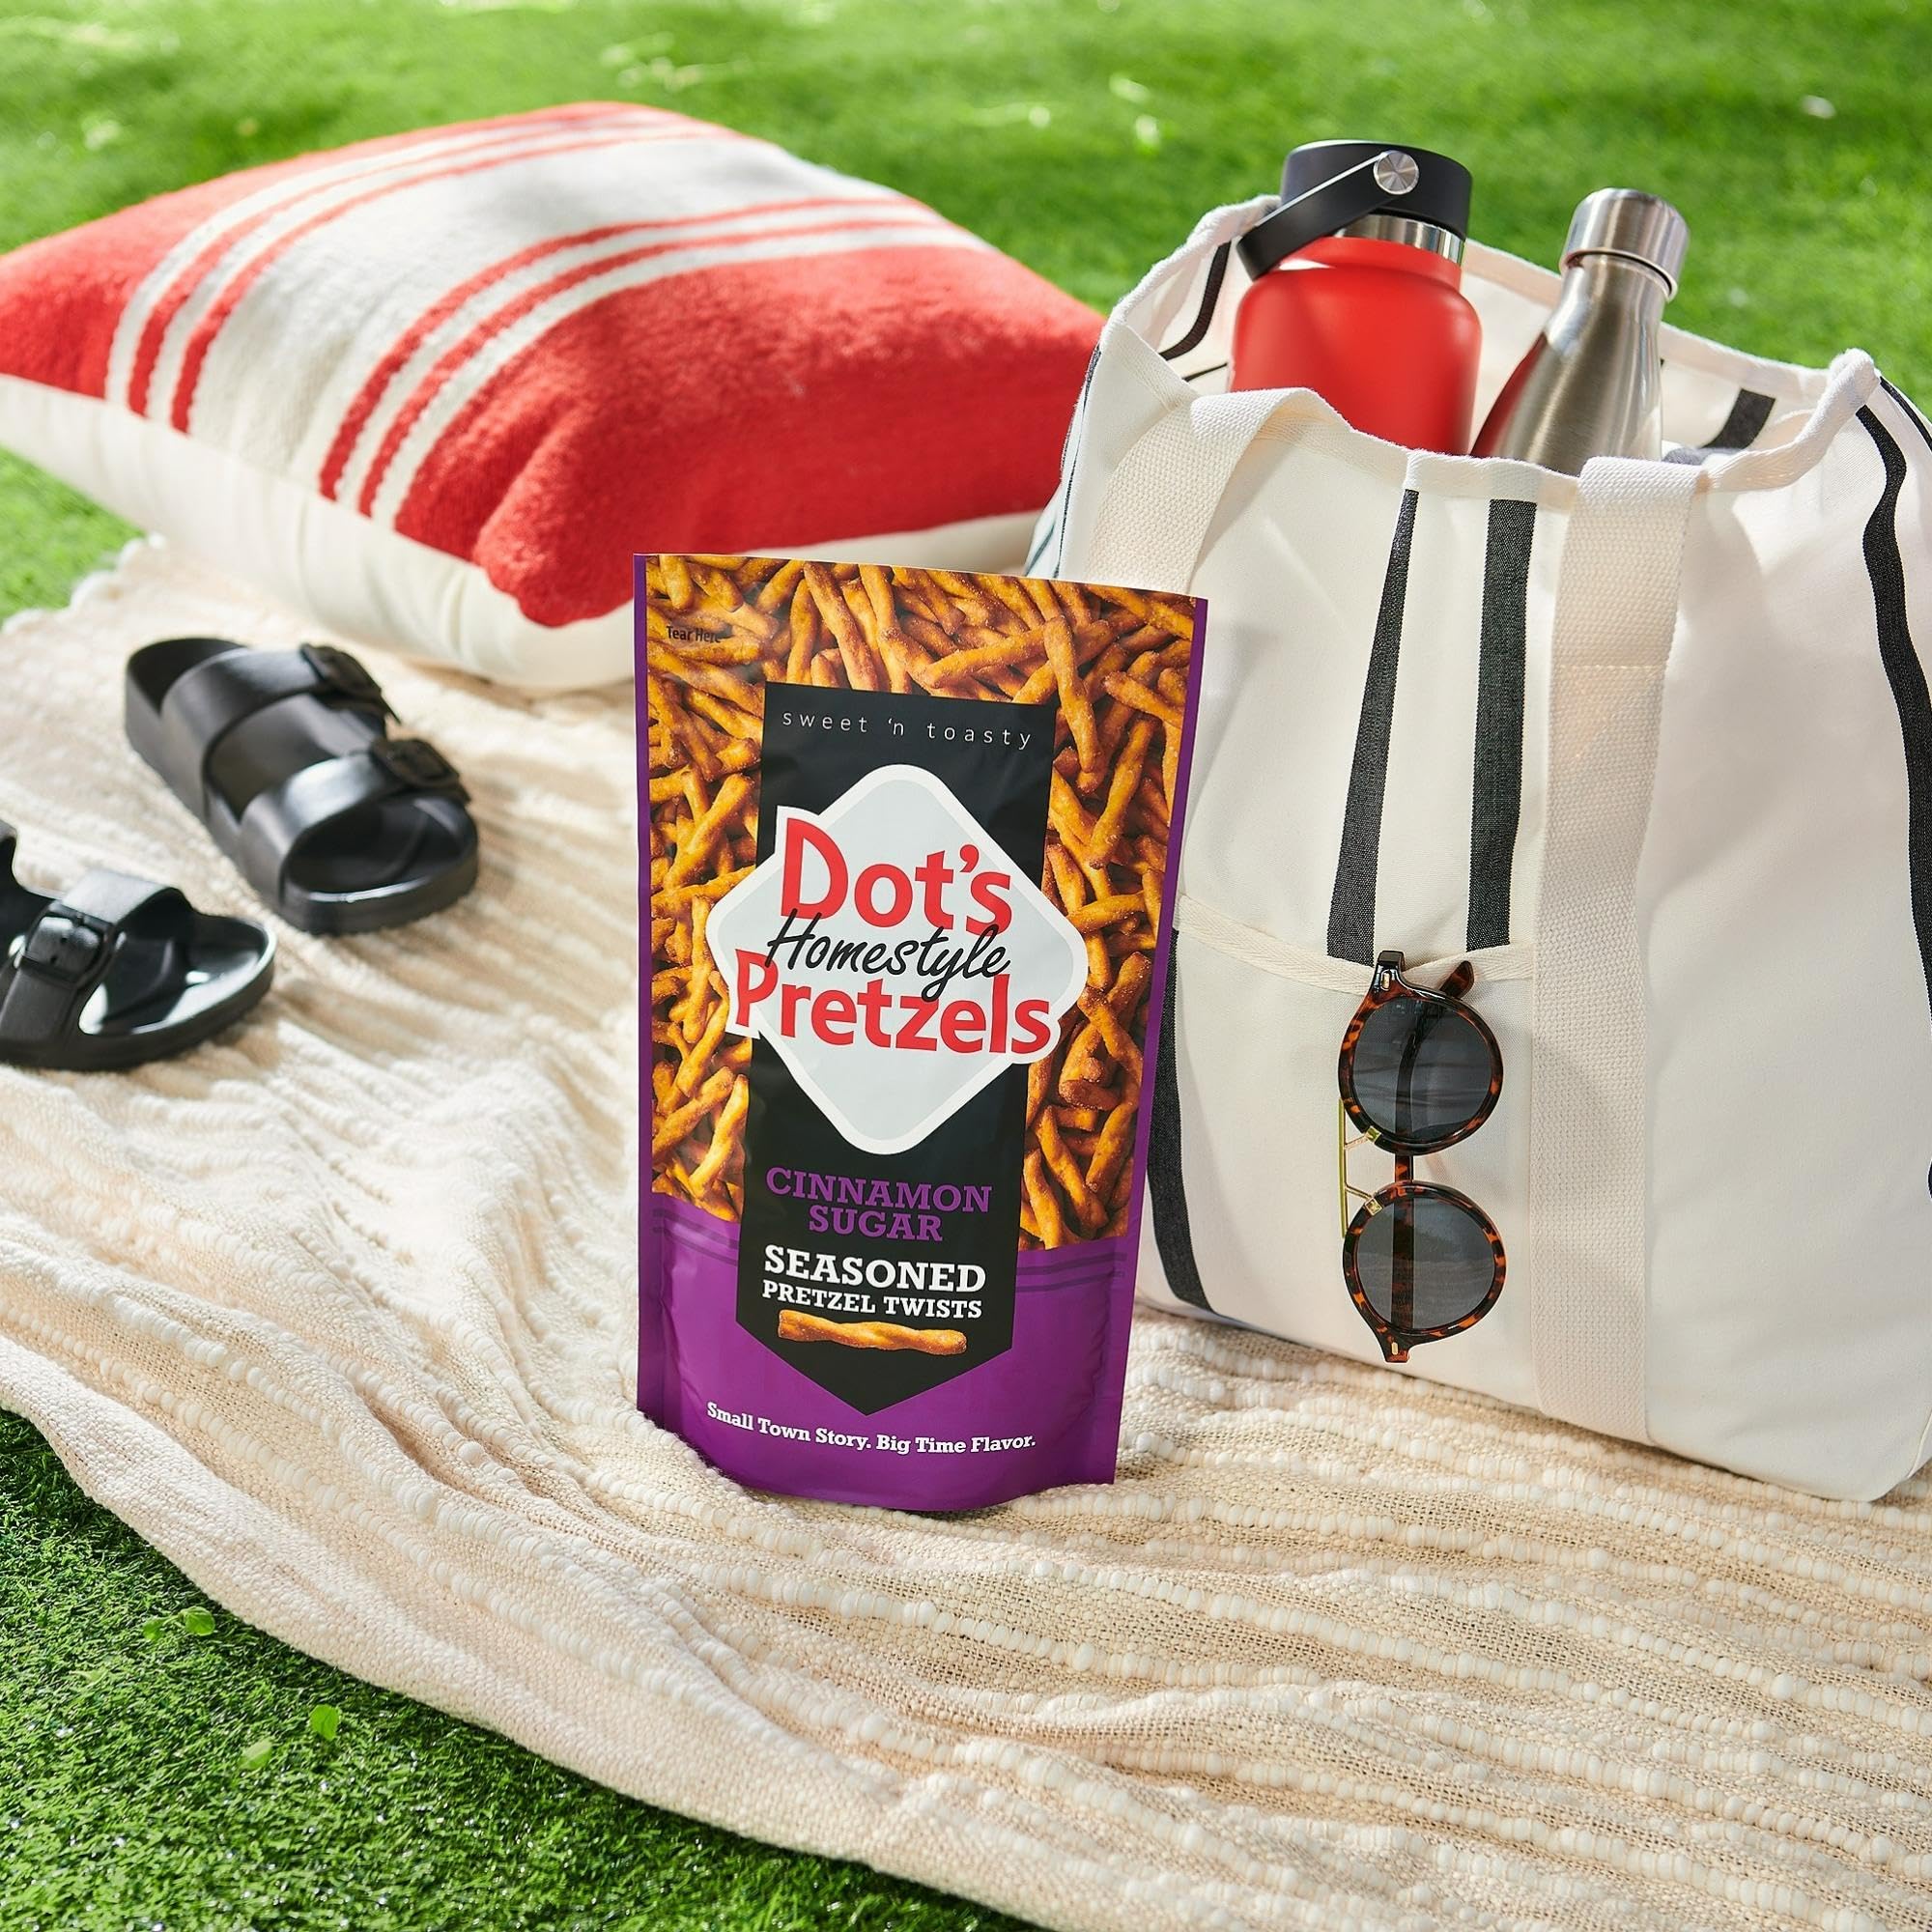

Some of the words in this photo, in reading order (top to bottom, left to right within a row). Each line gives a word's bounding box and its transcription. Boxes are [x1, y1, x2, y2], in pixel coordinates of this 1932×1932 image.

[667, 626, 693, 640] Tear
[782, 712, 867, 733] sweet
[888, 718, 904, 736] 'n
[926, 723, 1031, 750] toasty
[781, 817, 1013, 937] Dot's
[765, 907, 1011, 1003] Homestyle
[735, 948, 1052, 1055] Pretzels
[766, 1167, 993, 1212] CINNAMON
[809, 1205, 943, 1241] SUGAR
[764, 1244, 986, 1293] SEASONED
[762, 1279, 875, 1314] PRETZEL
[883, 1295, 982, 1319] TWISTS
[707, 1402, 753, 1431] Small
[757, 1417, 810, 1442] Town
[815, 1428, 871, 1450] Story.
[876, 1435, 910, 1455] Big
[915, 1436, 966, 1454] Time
[971, 1434, 1037, 1452] Flavor.
